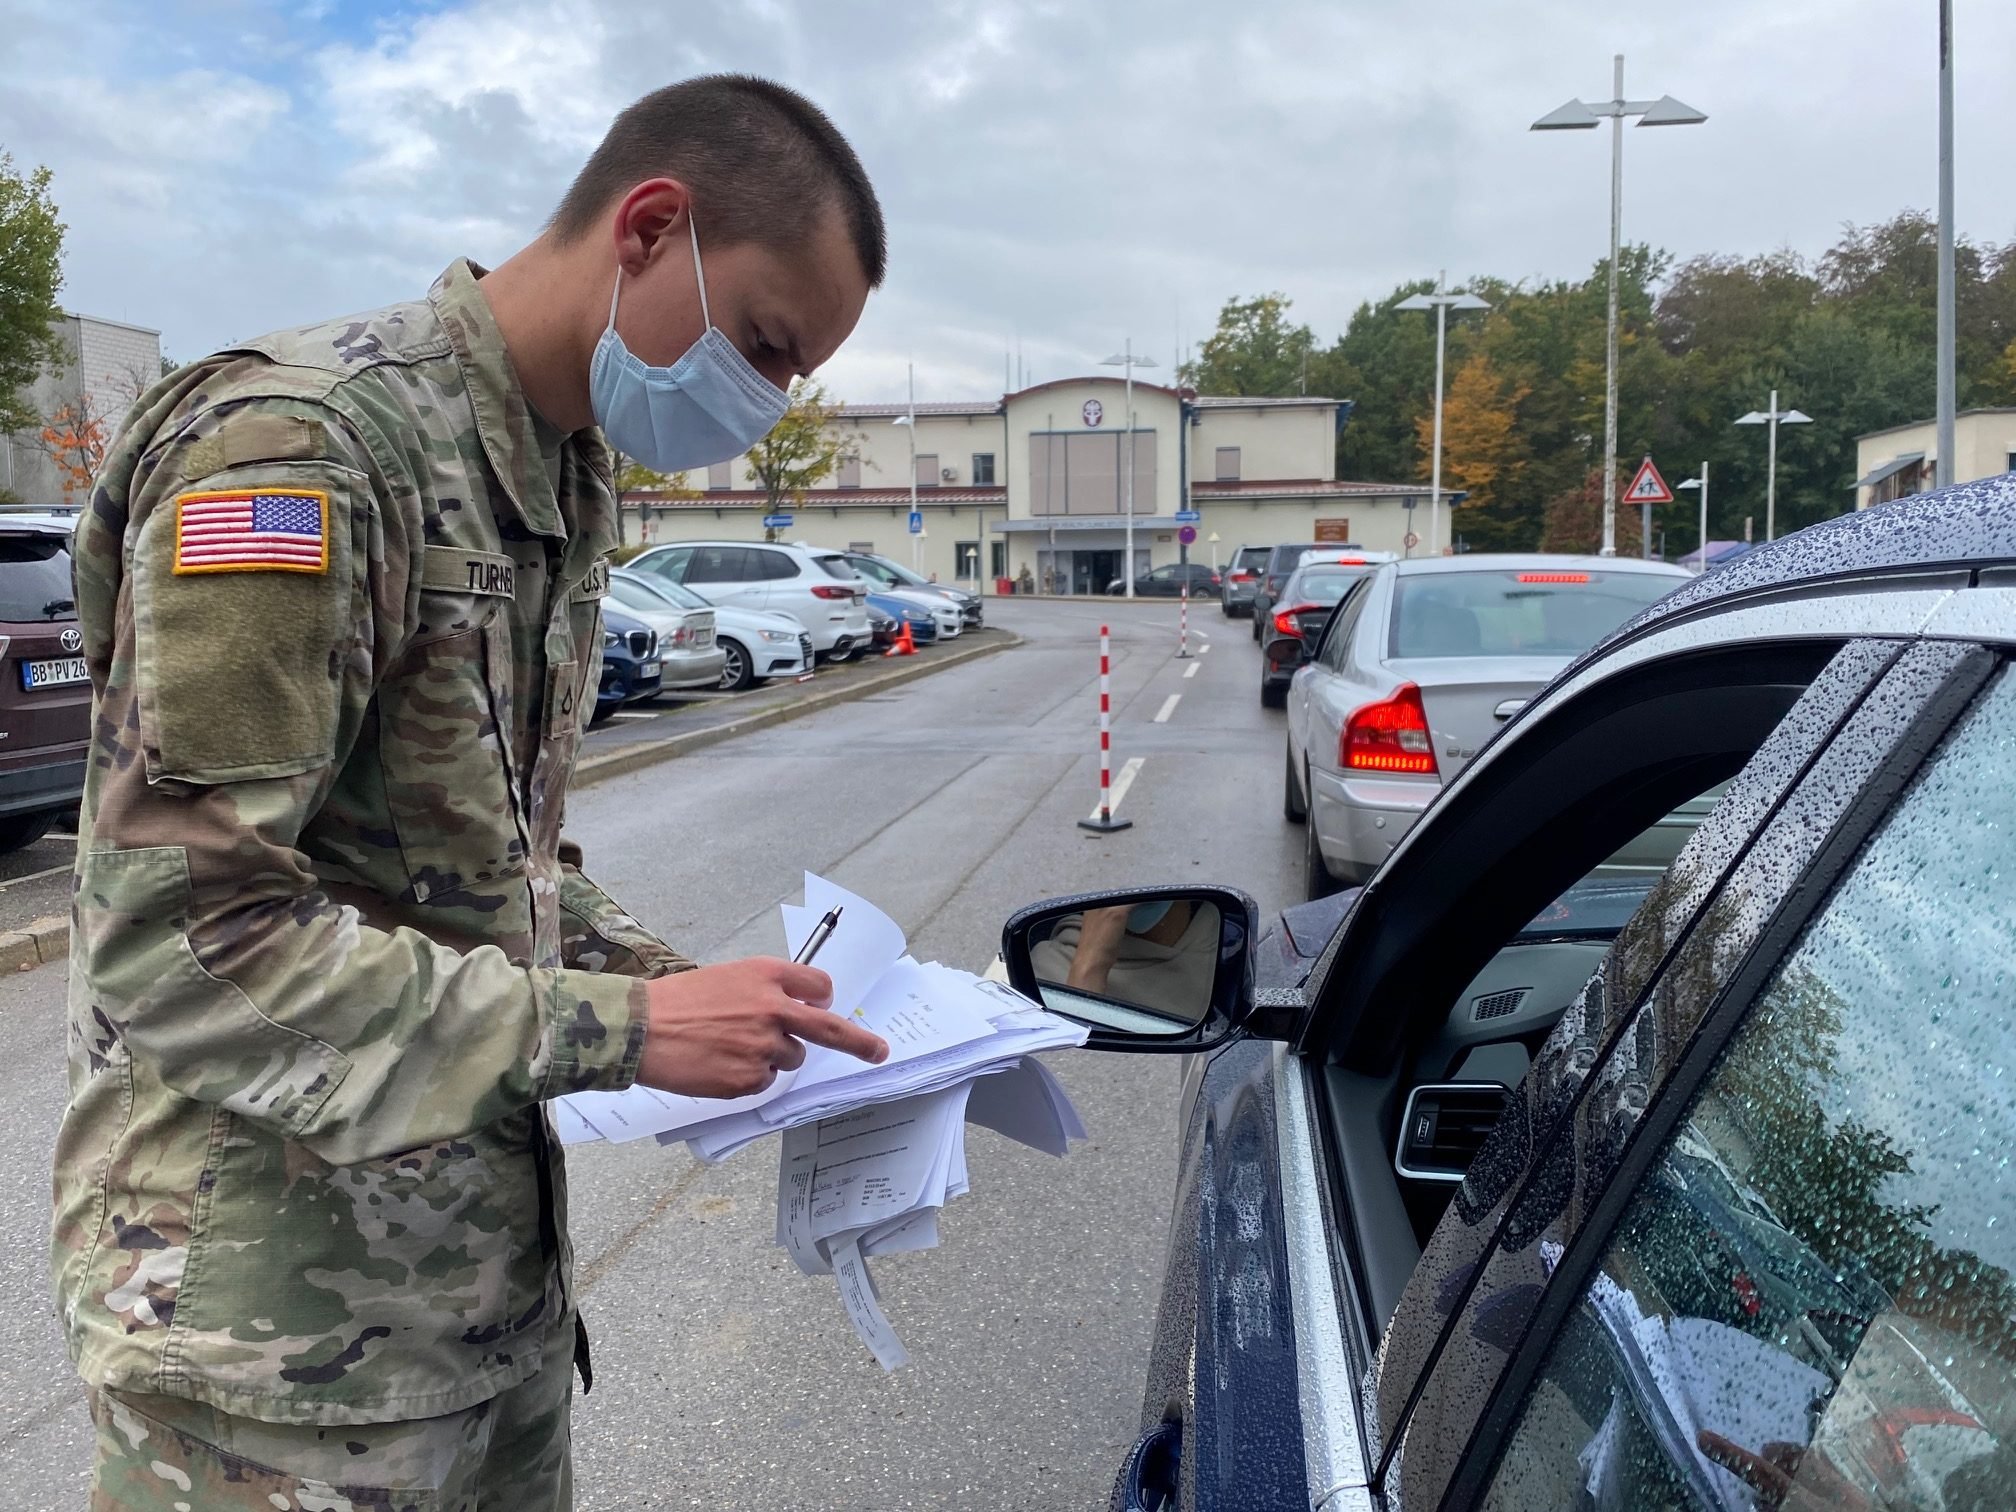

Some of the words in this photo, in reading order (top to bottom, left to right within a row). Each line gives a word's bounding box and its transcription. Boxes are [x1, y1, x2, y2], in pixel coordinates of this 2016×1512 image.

[466, 561, 513, 593] TURNE
[582, 566, 602, 593] U.S.
[31, 664, 47, 683] BB
[55, 661, 69, 680] PV
[72, 659, 90, 678] 26
